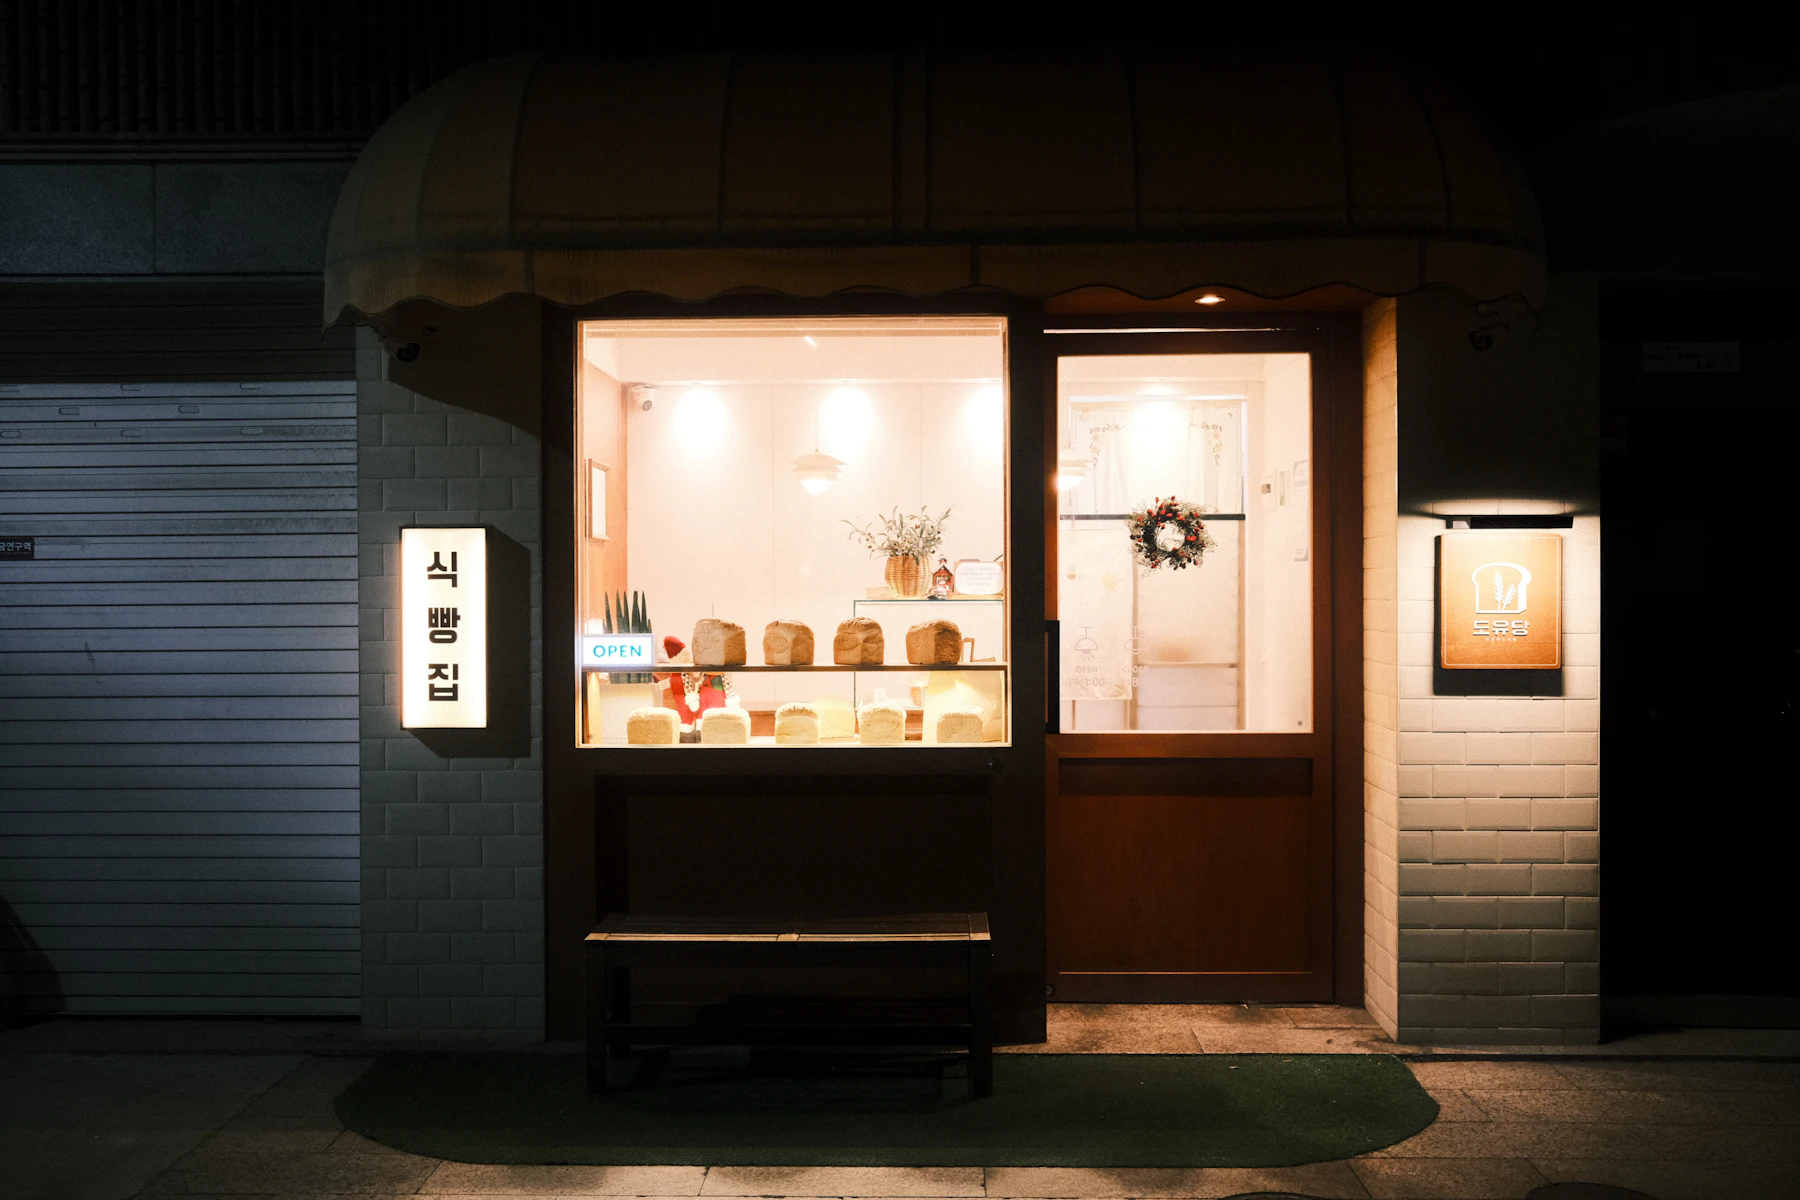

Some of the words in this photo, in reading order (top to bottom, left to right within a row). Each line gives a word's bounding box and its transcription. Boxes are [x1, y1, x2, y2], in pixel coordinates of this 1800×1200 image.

[427, 551, 461, 702] 식빵집
[1473, 620, 1530, 636] 도유당
[593, 645, 642, 658] OPEN
